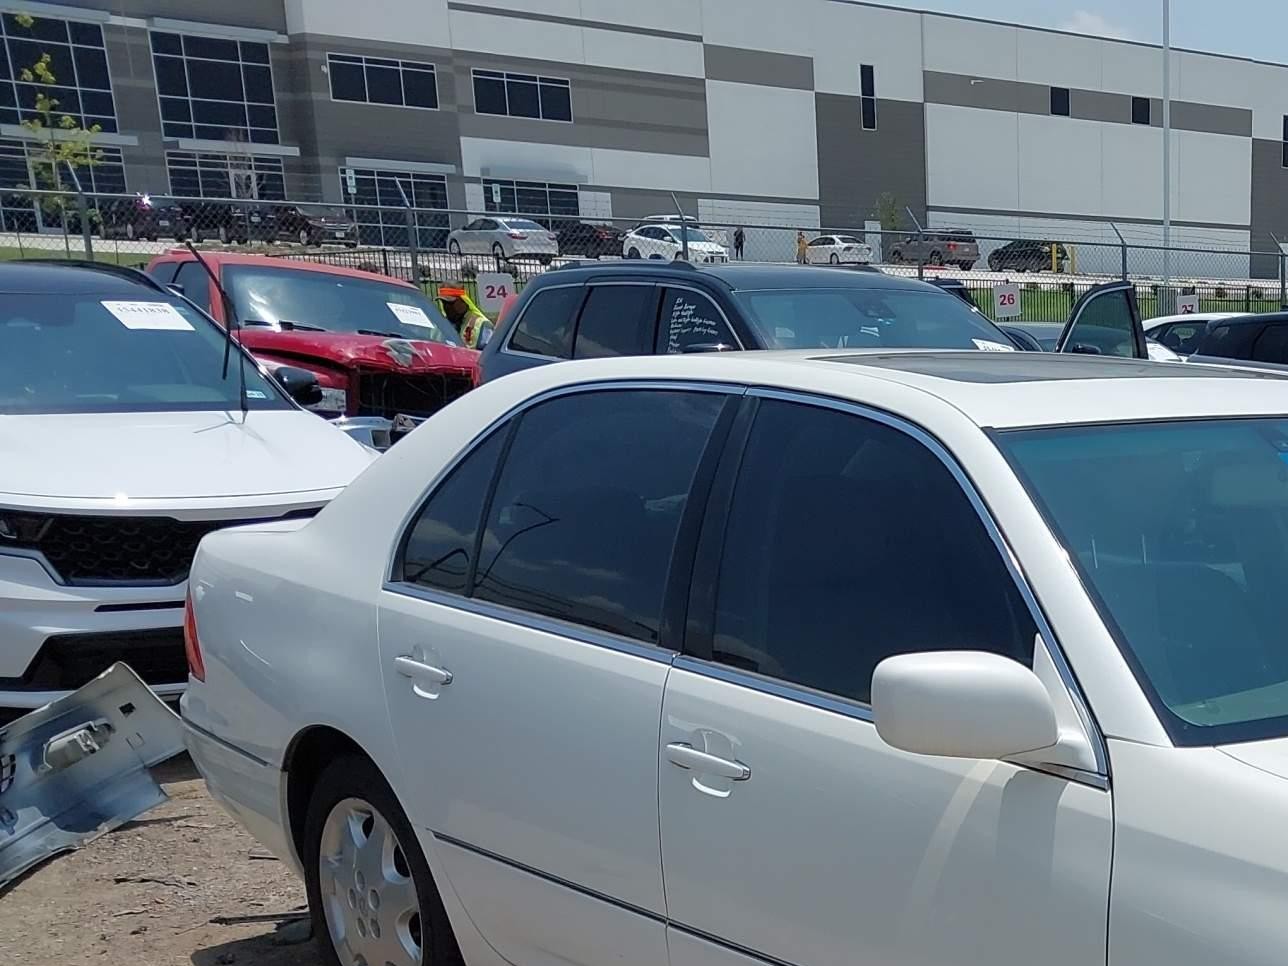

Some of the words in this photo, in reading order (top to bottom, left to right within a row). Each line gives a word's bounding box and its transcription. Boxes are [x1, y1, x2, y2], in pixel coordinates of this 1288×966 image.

[485, 285, 508, 298] 24
[1000, 294, 1015, 305] 26
[1182, 304, 1194, 314] 27
